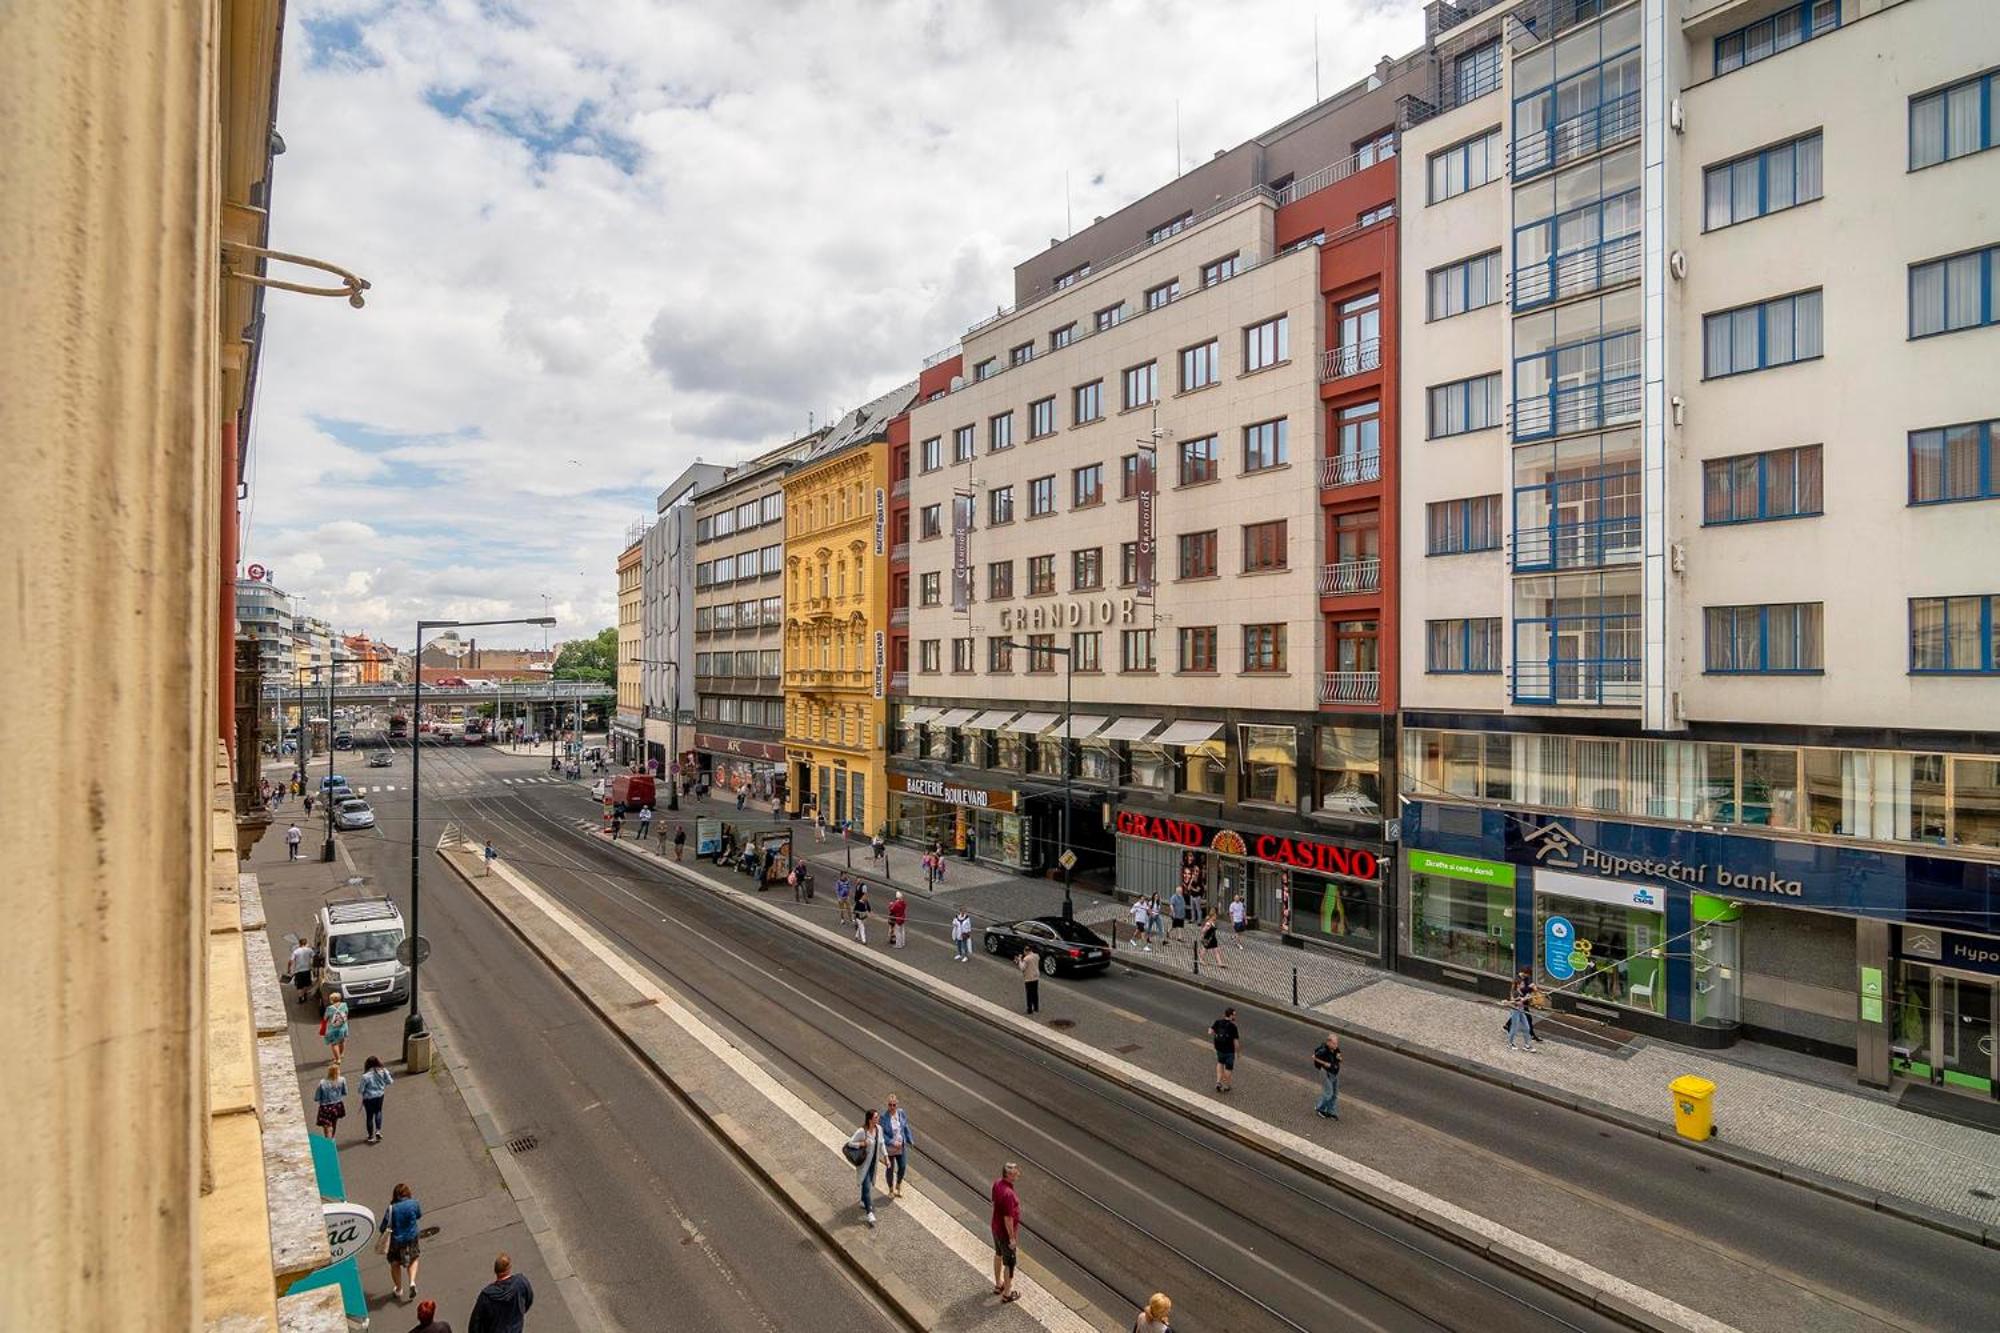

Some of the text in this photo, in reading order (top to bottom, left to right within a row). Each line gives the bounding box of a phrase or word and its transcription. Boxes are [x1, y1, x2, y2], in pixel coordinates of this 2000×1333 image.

[1140, 490, 1150, 553] GRANDIOR
[1000, 597, 1135, 632] GRANDIOR
[727, 739, 742, 752] KFC
[906, 778, 988, 807] BAGETERIE BOULEVARD
[1116, 811, 1377, 880] GRAND CASINO
[1582, 848, 1802, 897] Hypoteční banka
[1954, 944, 2000, 963] Hypo
